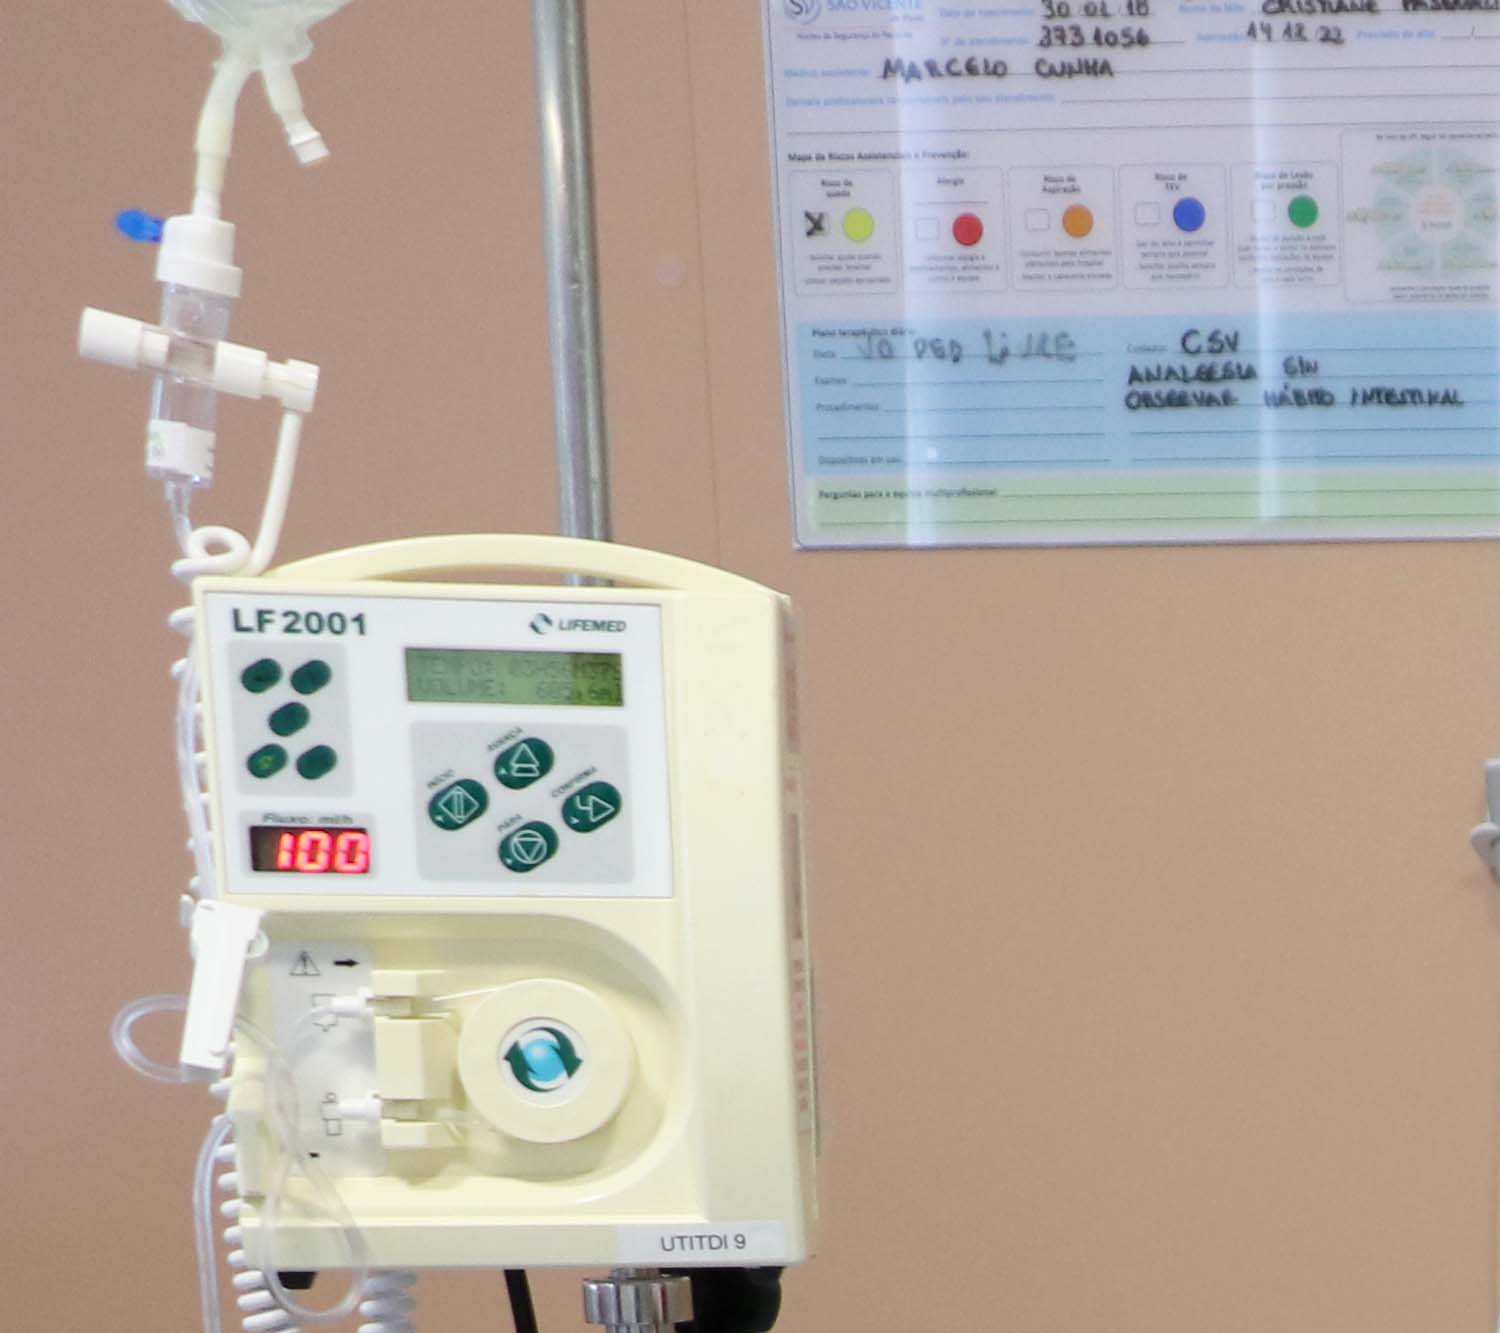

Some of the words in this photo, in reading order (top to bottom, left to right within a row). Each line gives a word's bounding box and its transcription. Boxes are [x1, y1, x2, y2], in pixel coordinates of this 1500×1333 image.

[881, 56, 1008, 84] MARCELO
[1034, 57, 1115, 79] CUNHA
[557, 618, 628, 633] LIFEMED
[276, 830, 372, 875] 100
[734, 1233, 747, 1250] 9
